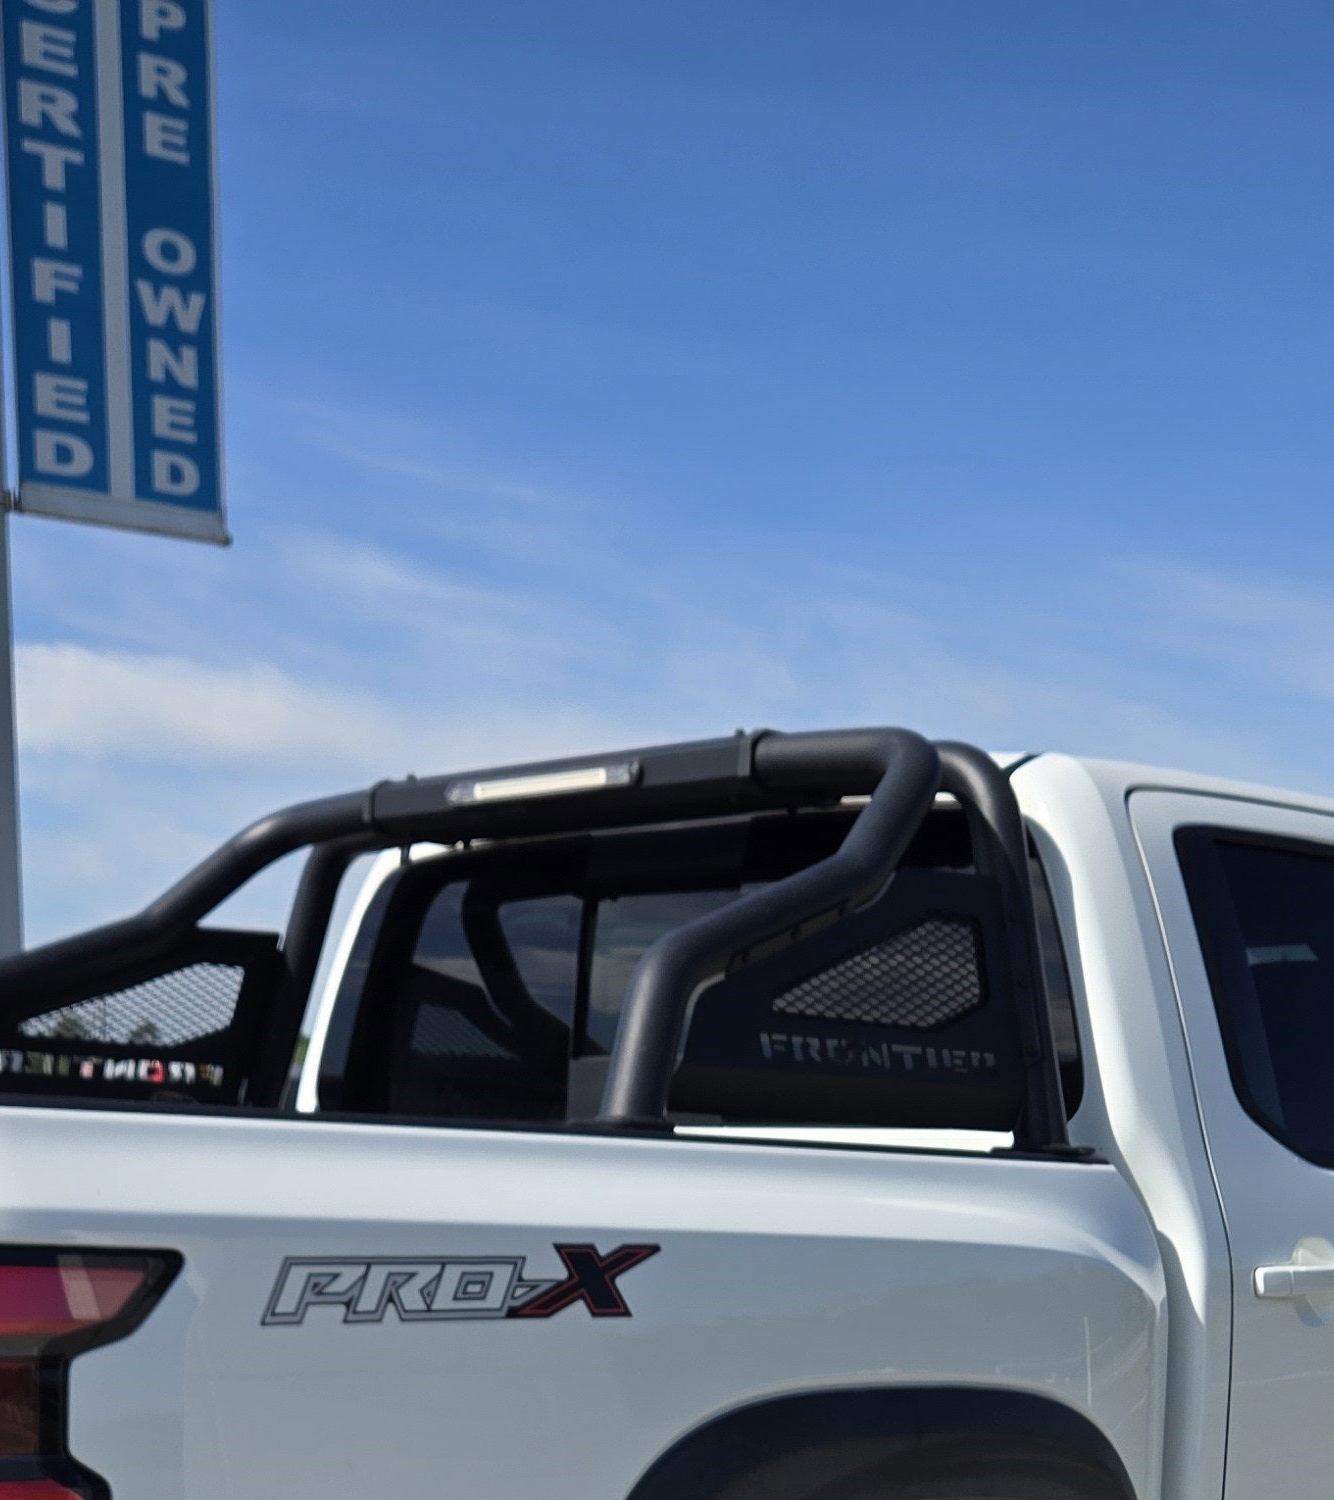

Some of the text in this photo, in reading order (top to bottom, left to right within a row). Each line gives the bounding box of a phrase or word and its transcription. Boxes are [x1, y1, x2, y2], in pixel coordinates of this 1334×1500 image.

[18, 0, 94, 478] ERTIFIED
[134, 0, 206, 497] PRE OWNED
[759, 1031, 998, 1074] FRONTIER
